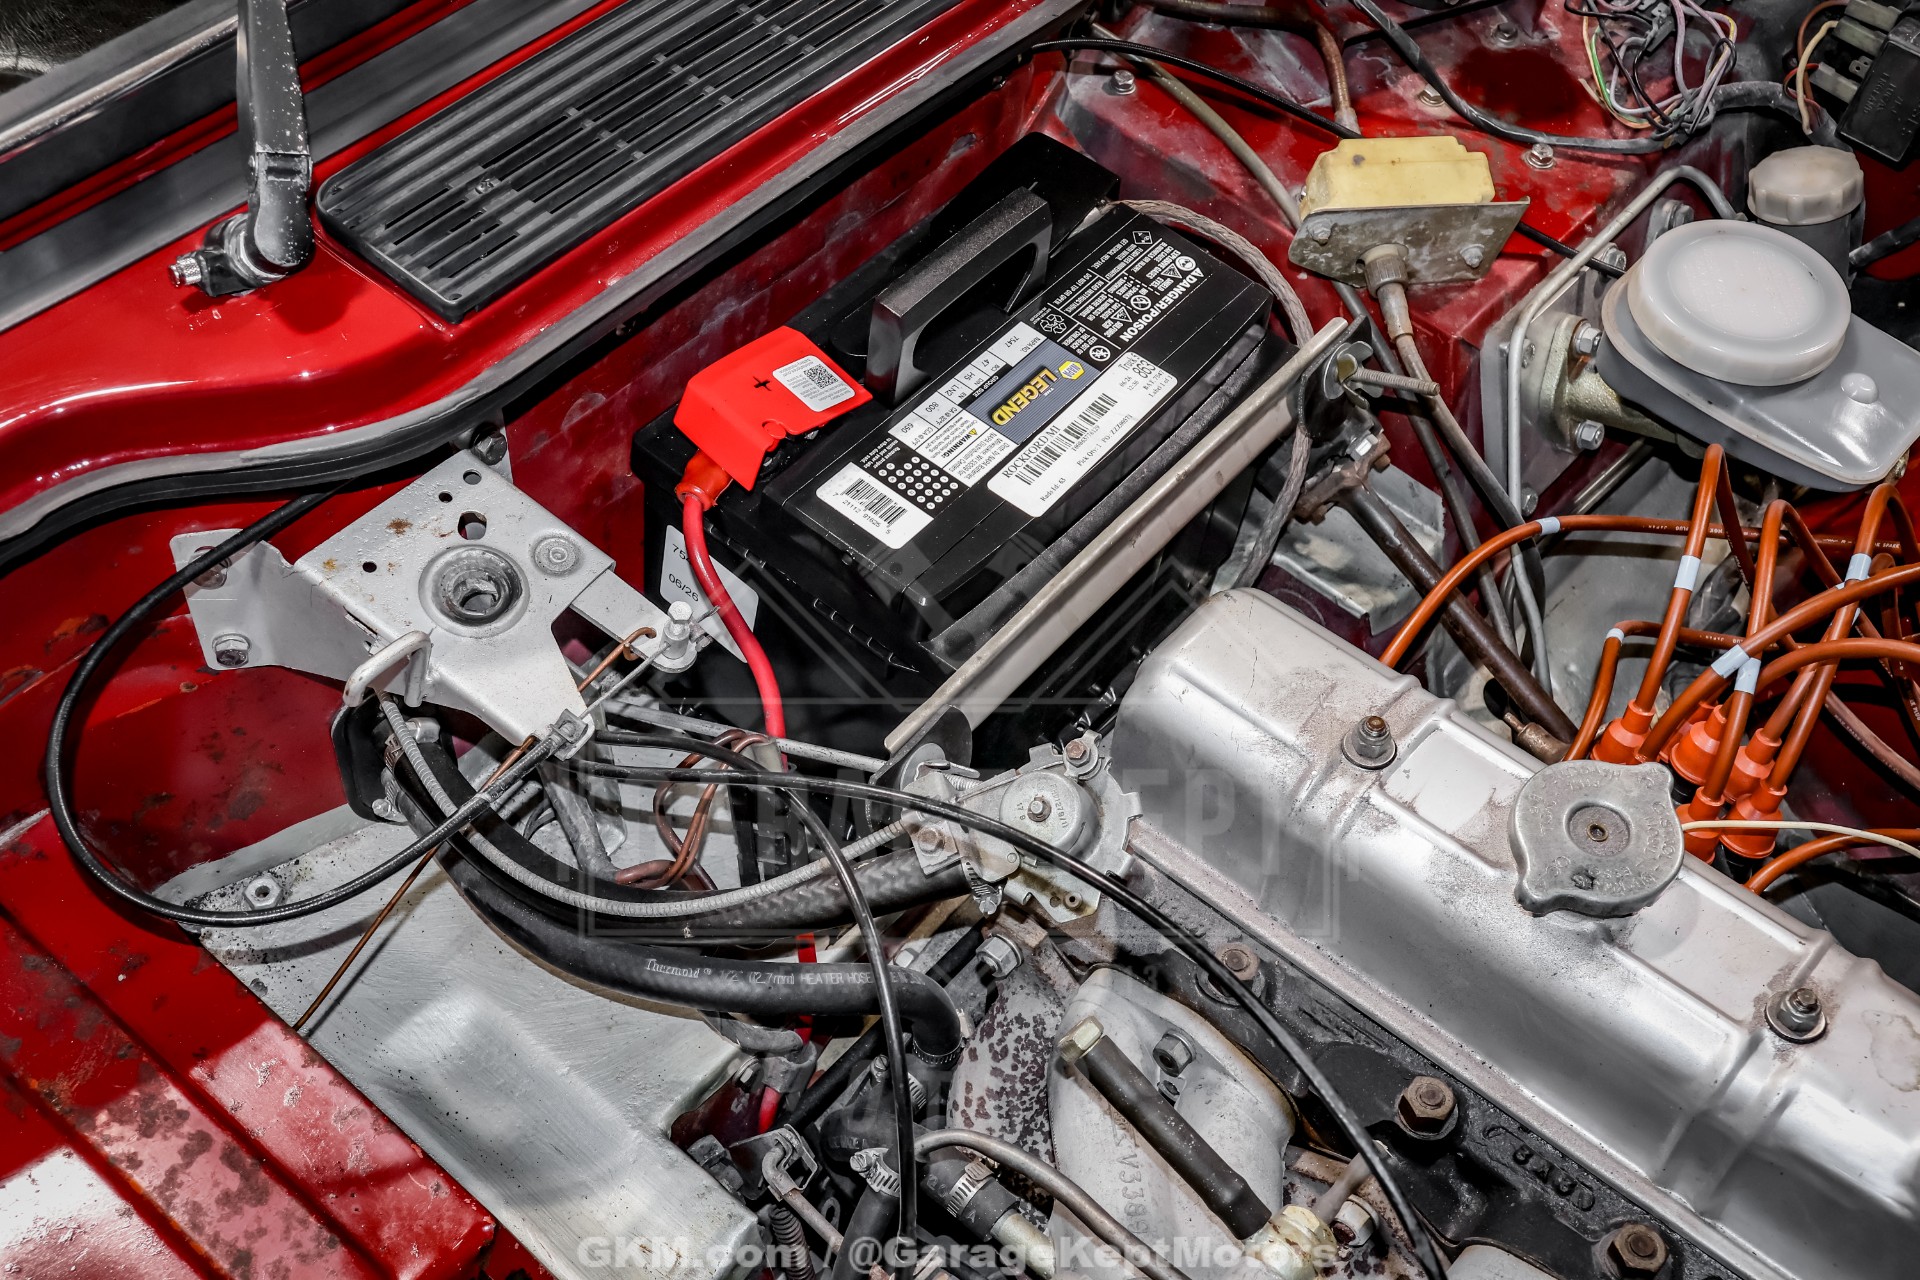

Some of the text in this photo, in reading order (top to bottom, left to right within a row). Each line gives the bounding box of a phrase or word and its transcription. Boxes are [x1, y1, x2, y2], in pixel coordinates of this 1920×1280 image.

[1117, 273, 1198, 343] DANGER/POISON
[1002, 334, 1020, 348] 7547
[979, 357, 991, 367] 47
[1130, 358, 1157, 379] 863
[962, 371, 976, 381] H5
[943, 383, 960, 397] LN2
[985, 367, 1060, 428] LEGEND
[923, 400, 940, 413] 800
[899, 421, 915, 434] 650
[940, 432, 972, 459] WARNING:
[1000, 424, 1062, 479] ROCKFORD MI
[668, 572, 699, 603] 06/26
[800, 971, 845, 985] HEATER
[846, 971, 874, 984] HOSE
